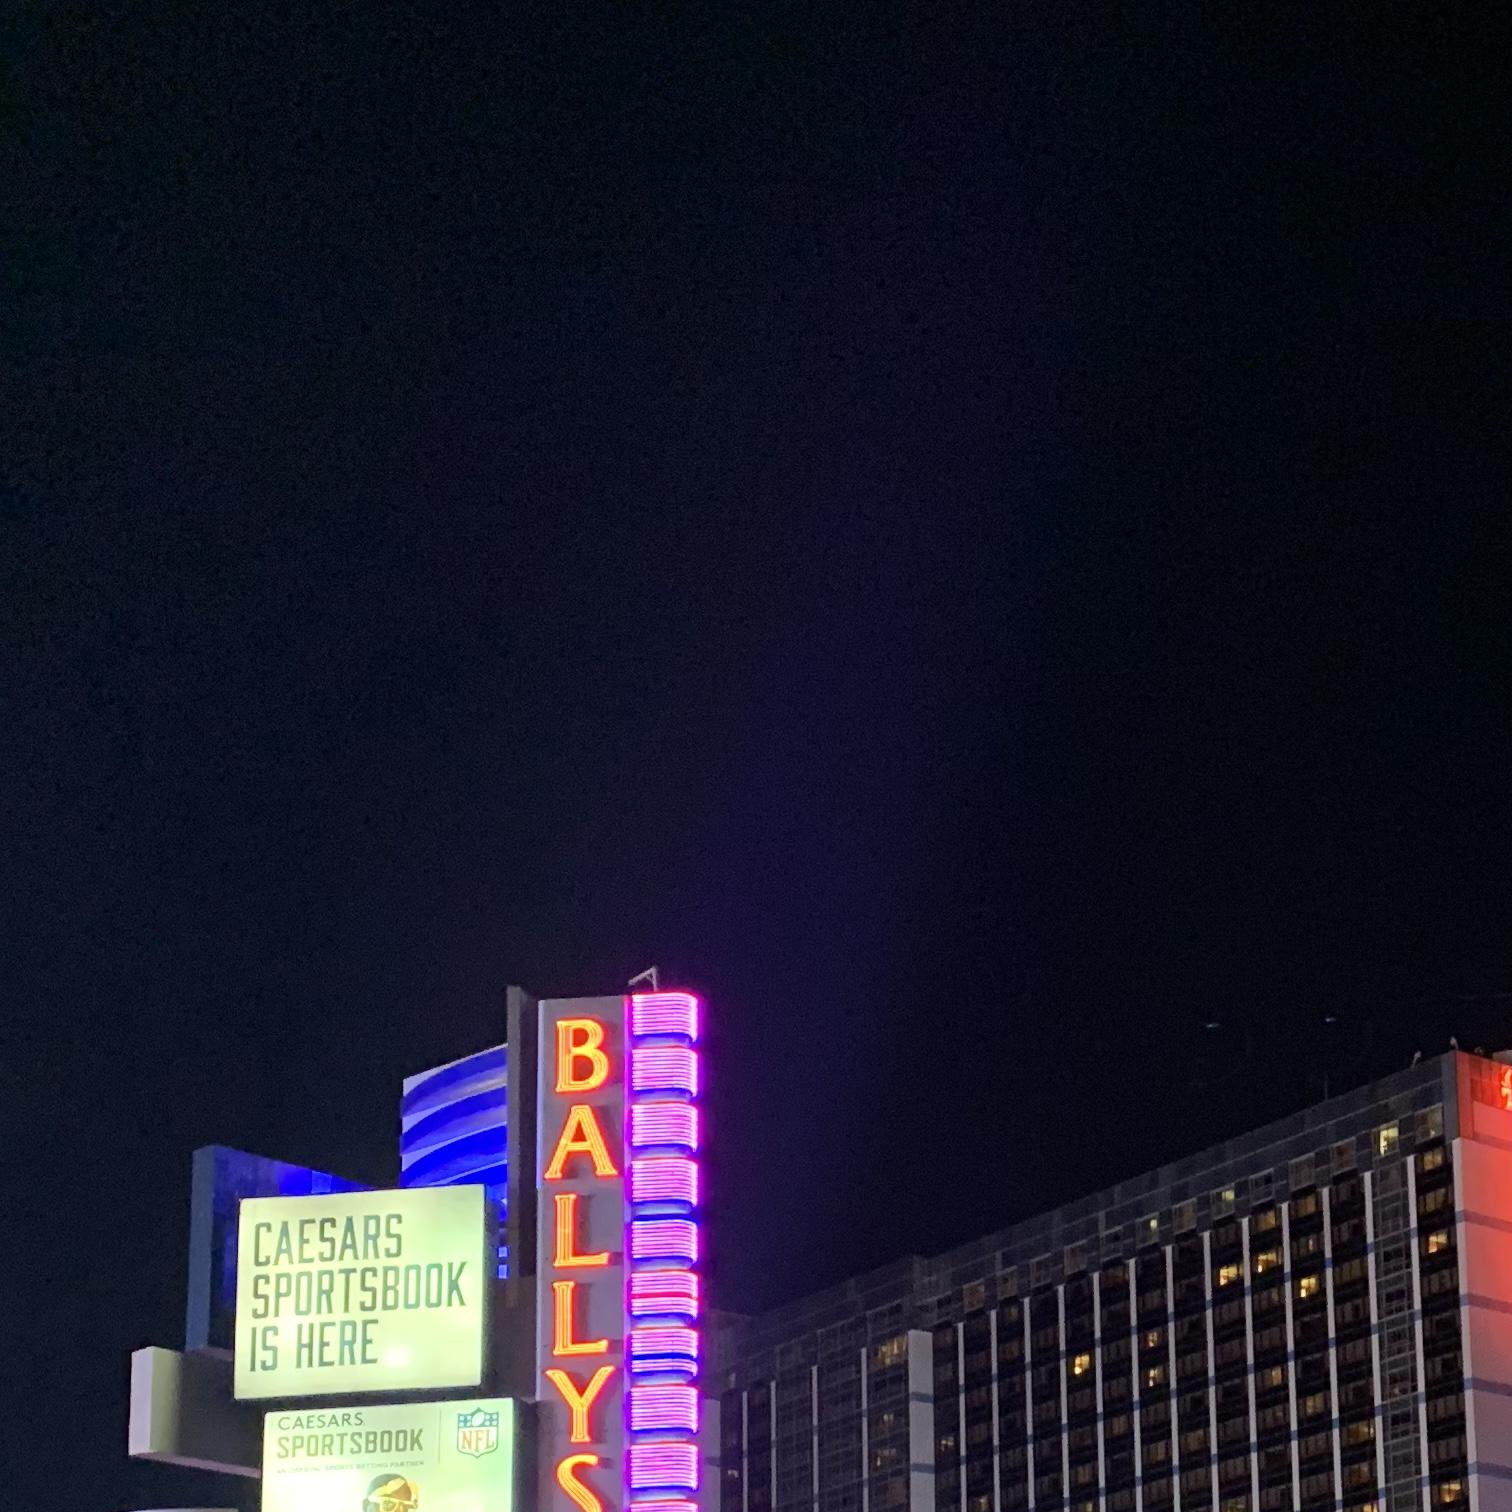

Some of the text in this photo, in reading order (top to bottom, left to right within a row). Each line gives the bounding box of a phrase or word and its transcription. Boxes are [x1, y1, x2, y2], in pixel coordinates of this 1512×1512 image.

[253, 1213, 402, 1267] CAESARS
[251, 1261, 467, 1319] SPORTSBOOK
[249, 1319, 379, 1372] IS HERE
[278, 1411, 364, 1431] CAESARS
[460, 1429, 495, 1452] NFL
[276, 1428, 424, 1459] SPORTSBOOK
